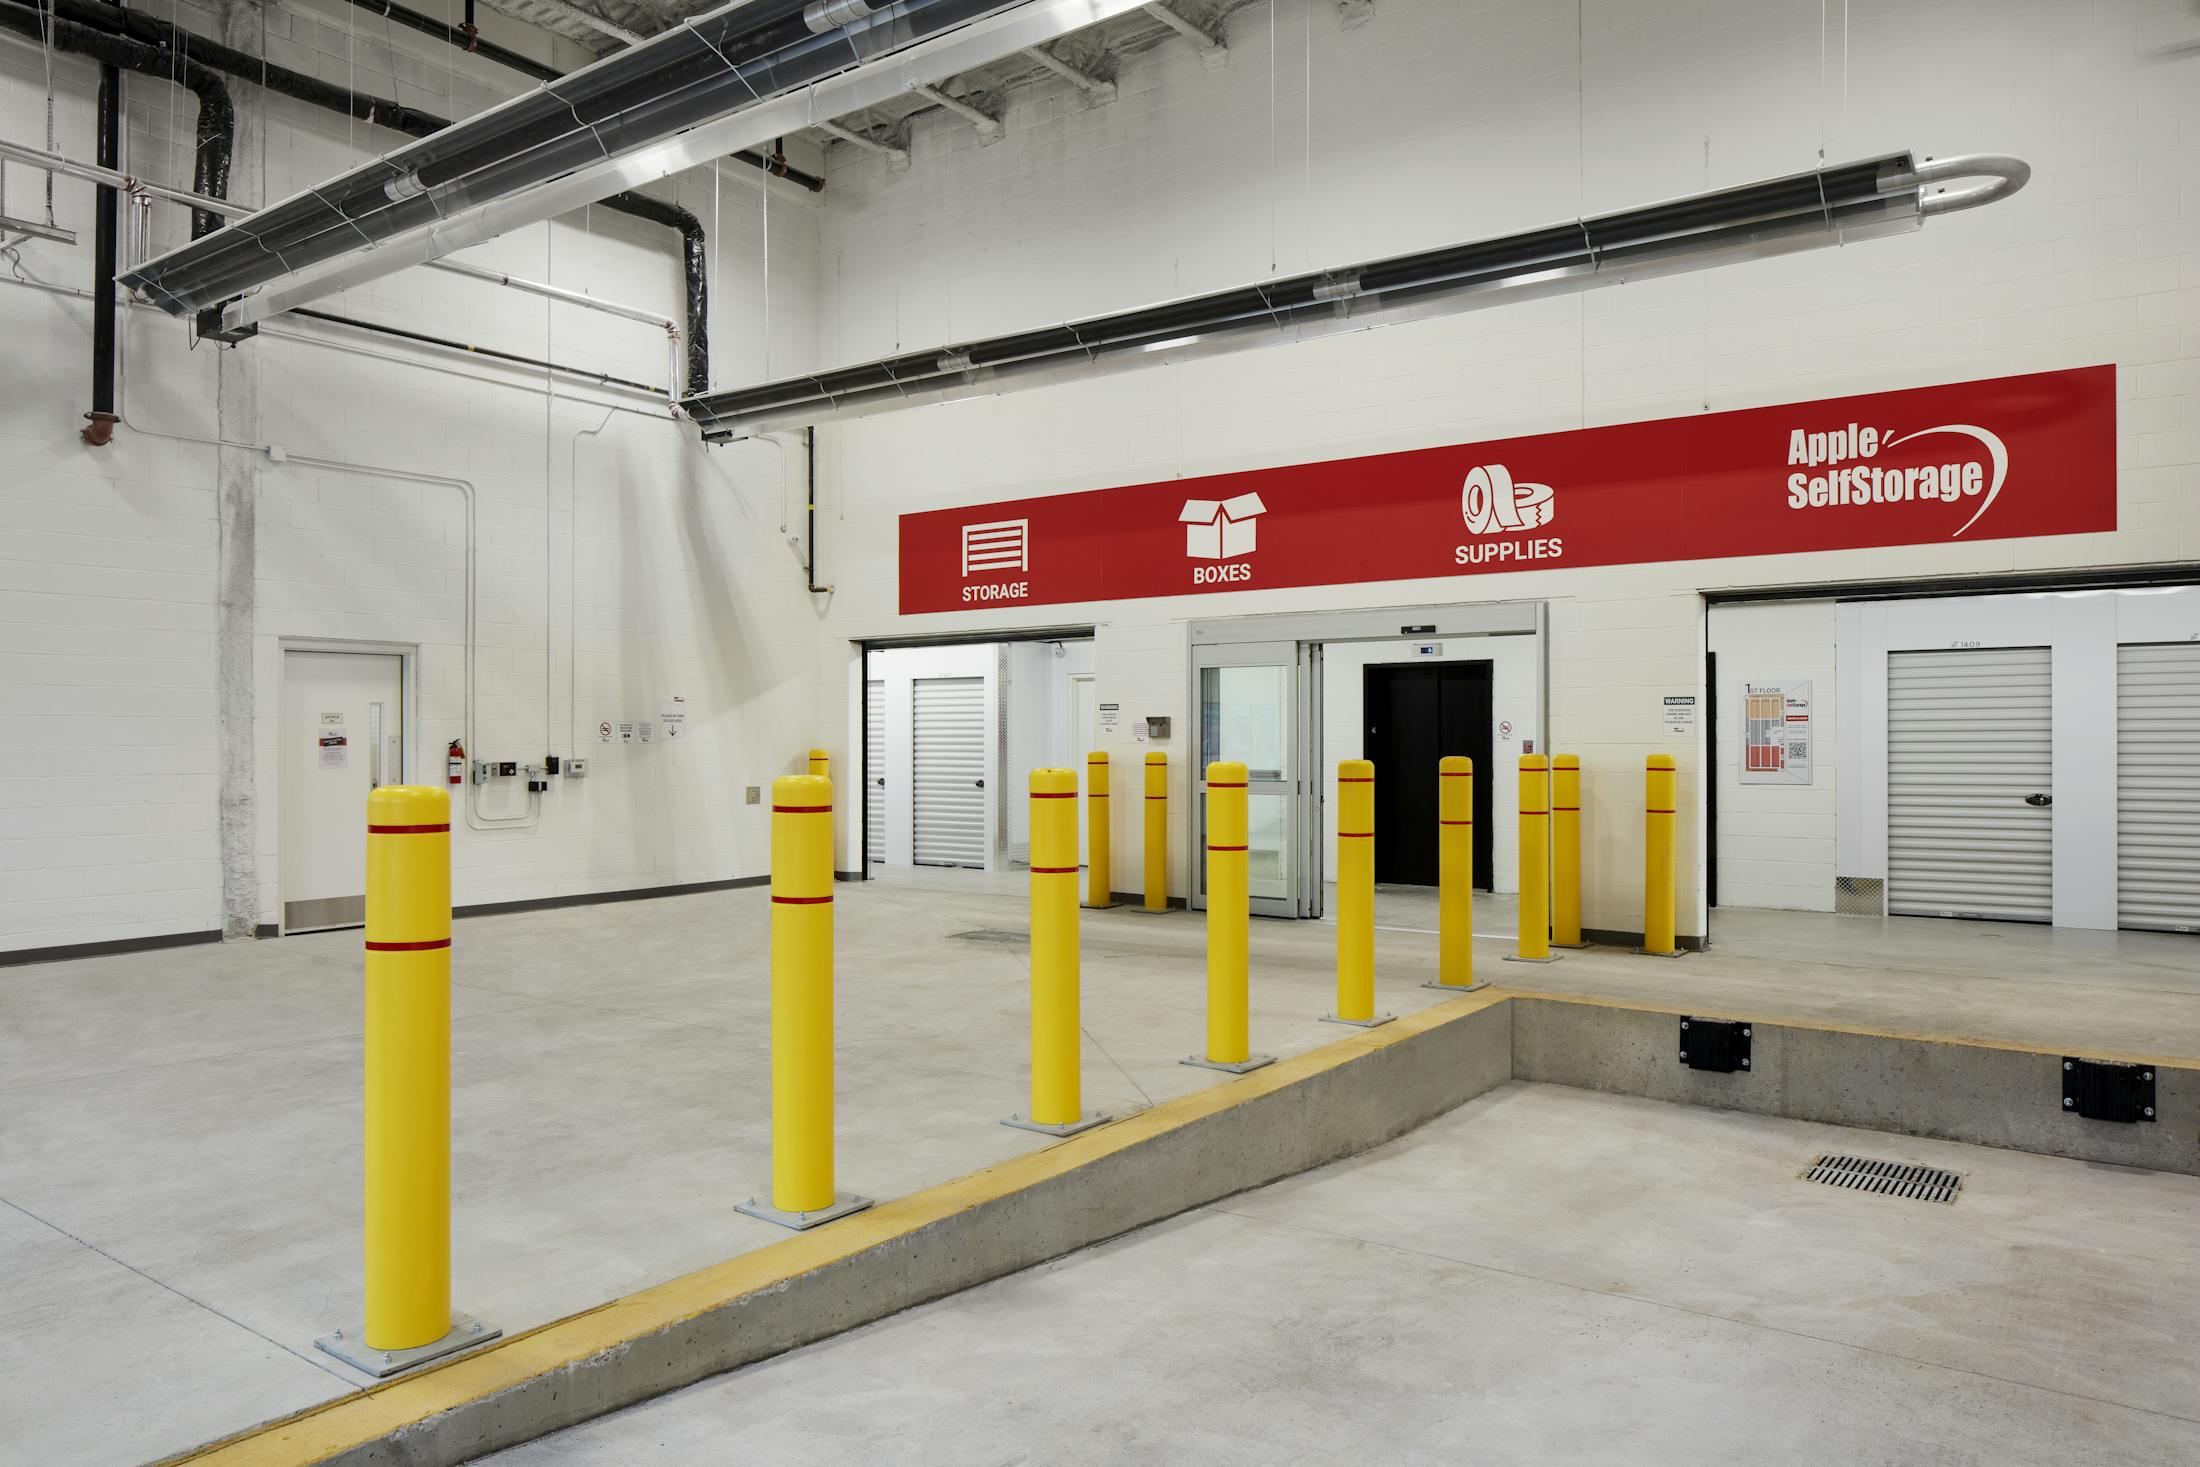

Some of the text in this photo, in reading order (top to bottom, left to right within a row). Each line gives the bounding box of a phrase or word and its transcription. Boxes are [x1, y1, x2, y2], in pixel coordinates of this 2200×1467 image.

[1787, 422, 1879, 467] Apple
[1787, 460, 1983, 510] SelfStorage
[1454, 537, 1563, 565] SUPPLIES
[1193, 563, 1252, 585] BOXES
[962, 582, 1028, 603] STORAGE
[1665, 697, 1694, 705] WARNING
